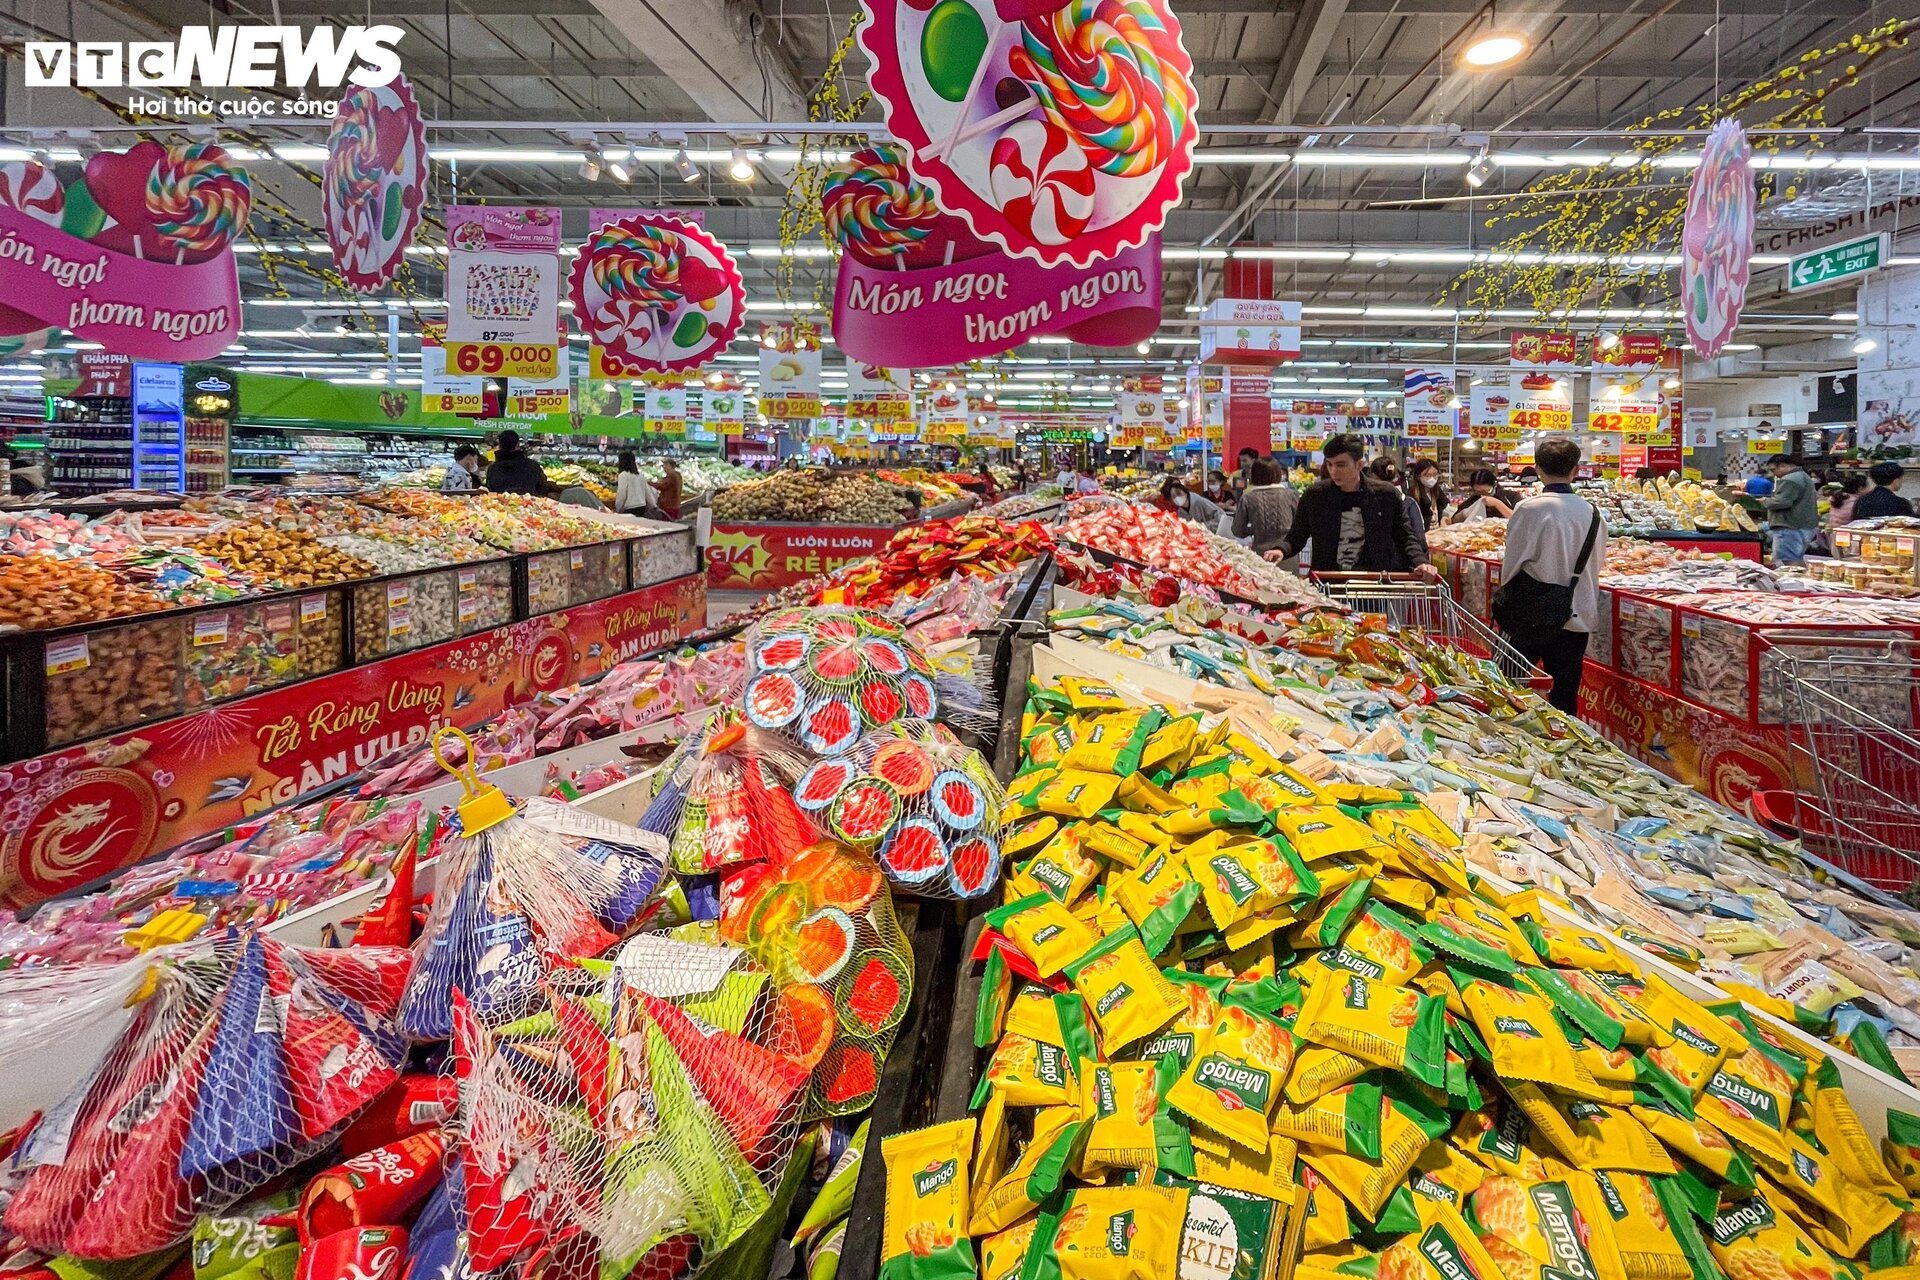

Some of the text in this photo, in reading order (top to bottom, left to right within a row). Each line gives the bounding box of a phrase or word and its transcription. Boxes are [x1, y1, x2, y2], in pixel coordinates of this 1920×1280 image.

[0, 226, 108, 290] ón ngọt
[1845, 256, 1870, 272] EXIT
[848, 271, 1009, 316] Món ngọt
[964, 267, 1144, 344] thơm ngon
[68, 297, 228, 341] thơm ngon
[457, 344, 552, 373] 69.000
[516, 365, 551, 375] vnd/kg
[516, 396, 562, 413] 15.900
[473, 420, 533, 430] FRESH EVERYDAY
[1471, 425, 1519, 439] 399.000
[1513, 411, 1568, 429] 48.900
[786, 535, 873, 549] LUÔN LUÔN
[786, 550, 821, 573] RẺ
[600, 638, 639, 672] NGÀN
[256, 679, 445, 764] Tết Rồng Vàng
[242, 751, 348, 819] NGÀN
[353, 728, 405, 767] ƯU
[1217, 857, 1257, 897] Mangó
[1329, 950, 1381, 978] Mangó
[1144, 1037, 1191, 1058] Mangó
[1676, 1028, 1717, 1053] Mangó
[1099, 1070, 1115, 1111] Mangó
[1198, 1061, 1265, 1093] Mangó
[1712, 1074, 1771, 1110] Mang
[920, 1165, 955, 1193] Mangó
[1112, 1216, 1128, 1251] Mangó
[1183, 1216, 1229, 1239] ssorted
[1536, 1191, 1594, 1279] Mangó
[1714, 1203, 1766, 1239] Mangó
